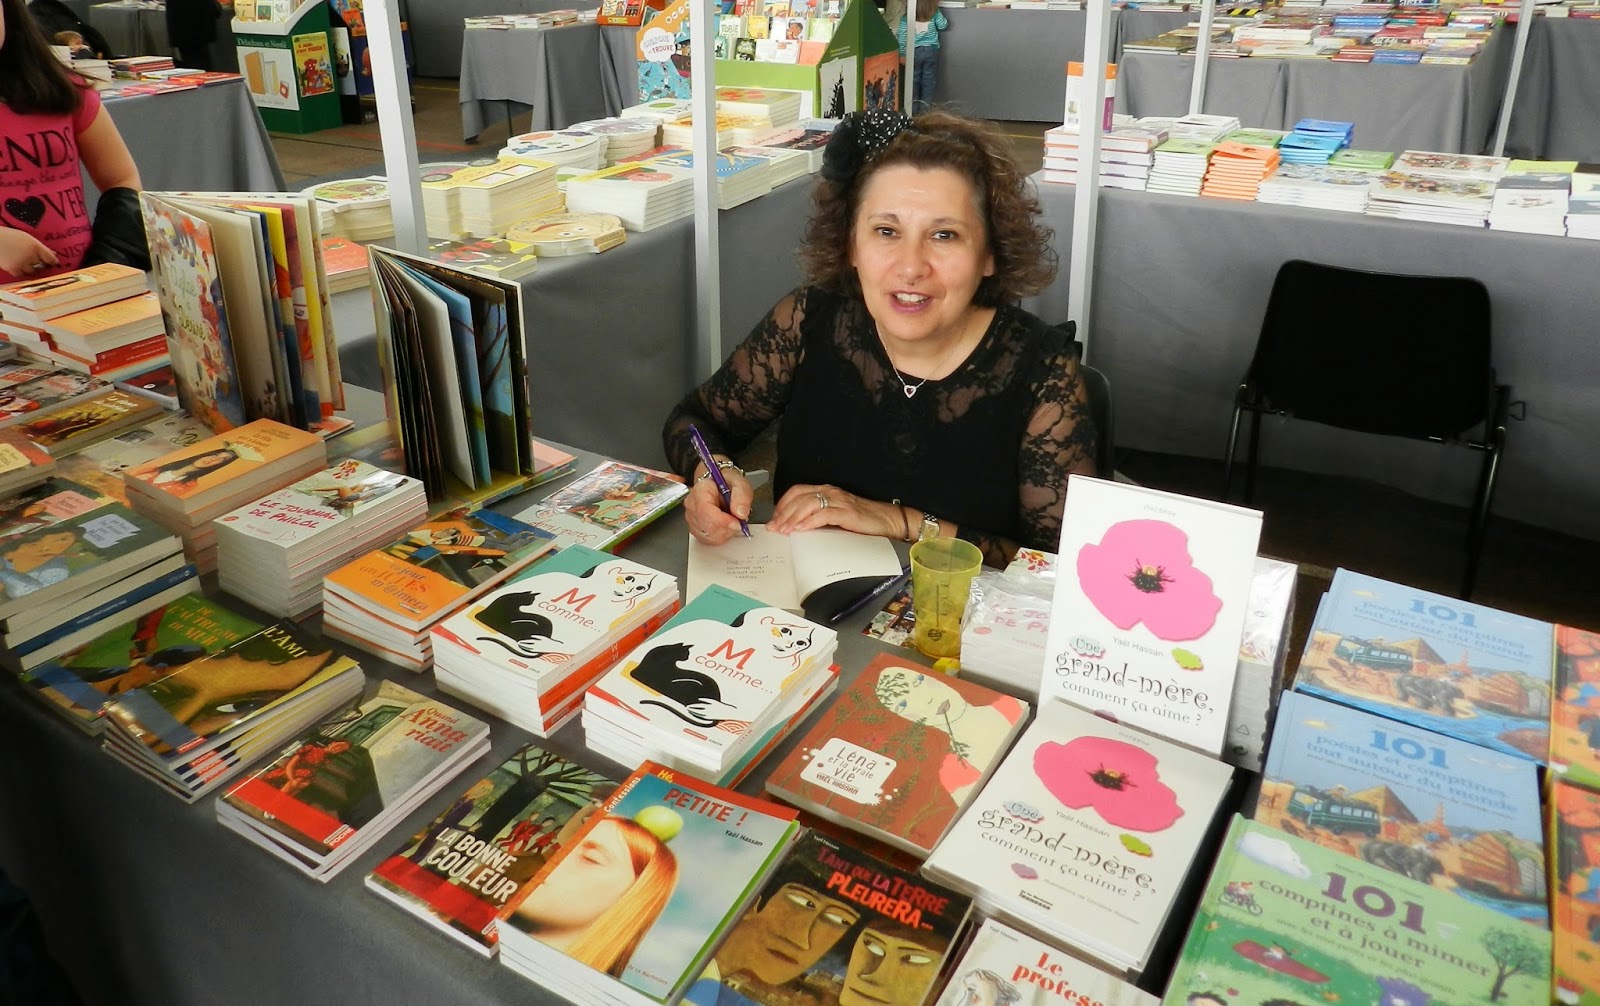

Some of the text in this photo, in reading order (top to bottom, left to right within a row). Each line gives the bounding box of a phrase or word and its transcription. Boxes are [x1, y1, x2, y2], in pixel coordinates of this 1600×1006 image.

[652, 44, 674, 54] TROUVE
[249, 508, 266, 517] DE
[280, 504, 340, 520] JOURNAL
[551, 587, 597, 613] M
[1409, 599, 1478, 629] 101
[263, 627, 307, 658] L'AMI
[707, 638, 756, 670] M
[1076, 638, 1100, 654] Une
[1132, 642, 1164, 657] Hassan
[1055, 651, 1214, 714] grand-mère,
[427, 708, 460, 724] Quand
[1062, 680, 1203, 726] comment ça aime ?
[400, 708, 469, 742] Anna
[405, 728, 453, 752] riait
[837, 746, 877, 770] Léna
[1307, 741, 1344, 758] tout
[1350, 755, 1410, 781] autour
[1417, 775, 1442, 787] du
[1369, 729, 1449, 769] 101
[832, 780, 859, 795] HASSAN
[834, 767, 855, 782] vie
[852, 766, 874, 779] vraie
[1407, 761, 1507, 797] comptines
[603, 776, 641, 813] Confessions
[663, 788, 749, 827] PETITE !
[1011, 802, 1039, 819] Une
[436, 827, 457, 845] LA
[725, 829, 763, 847] Yaël Hassan
[1075, 816, 1110, 838] Hassan
[455, 834, 518, 874] BONNE
[977, 806, 1157, 894] grand-mère,
[426, 845, 519, 903] COULEUR
[816, 847, 850, 873] TANT
[872, 873, 890, 892] LA
[890, 877, 949, 915] TERRE
[981, 831, 1141, 902] comment ça aime ?
[1321, 871, 1427, 935] 101
[1258, 879, 1377, 933] comptines
[1384, 923, 1399, 941] à
[1407, 932, 1491, 977] mimer
[1311, 915, 1426, 970] et à jouer
[1035, 950, 1063, 977] Le
[1012, 964, 1104, 1006] profes
